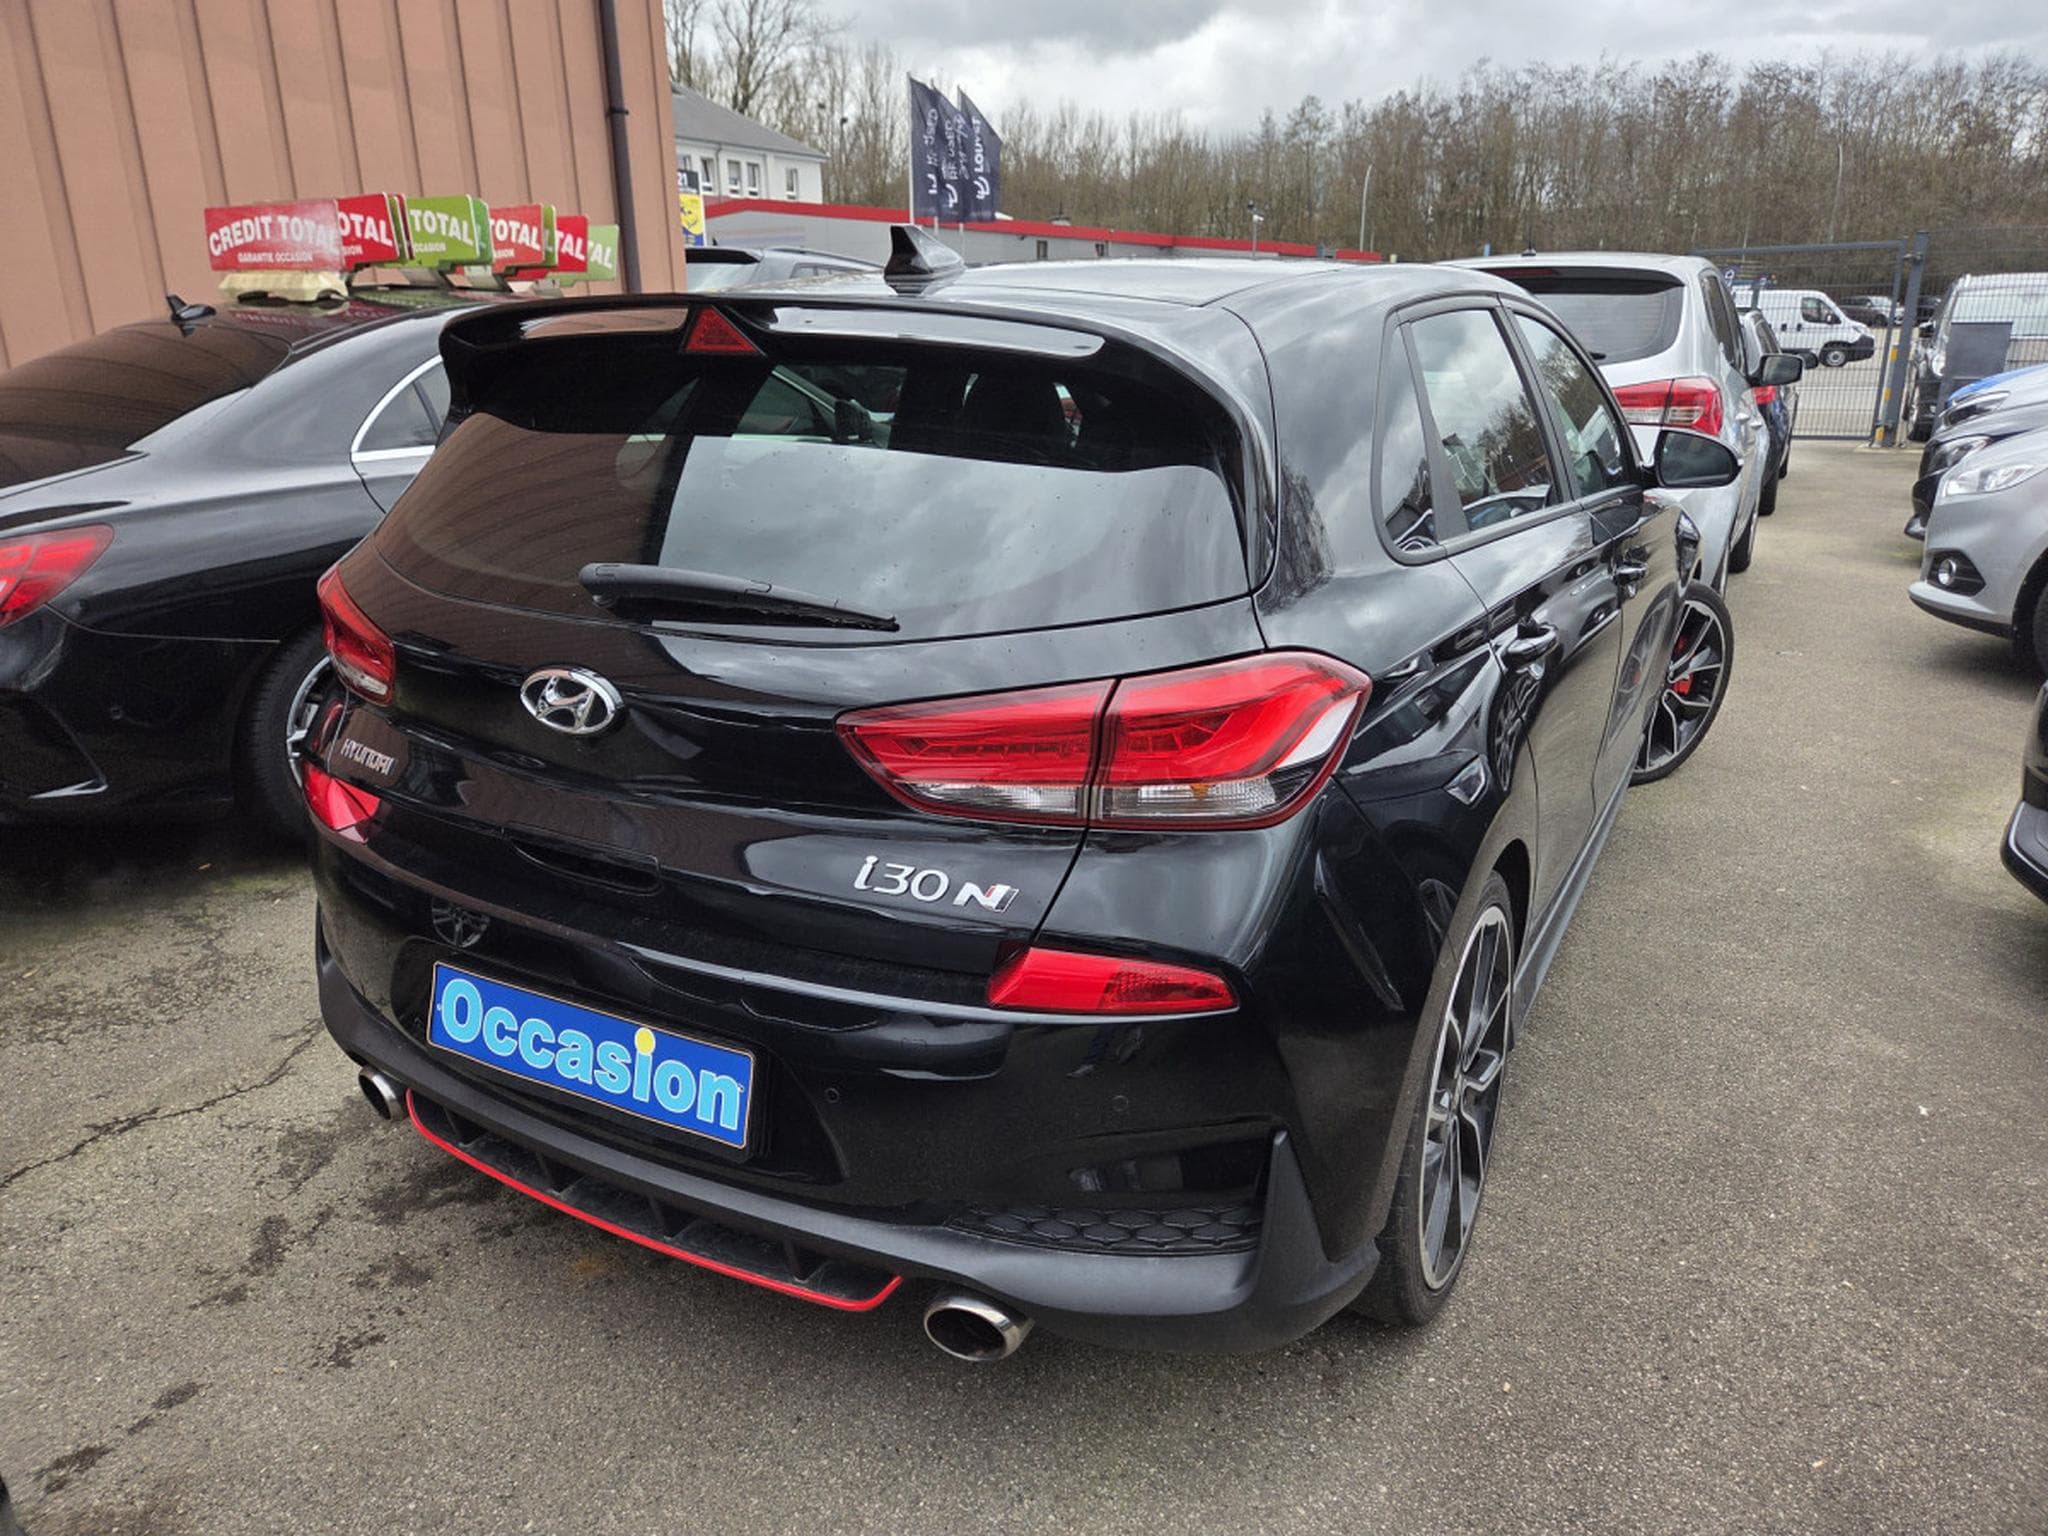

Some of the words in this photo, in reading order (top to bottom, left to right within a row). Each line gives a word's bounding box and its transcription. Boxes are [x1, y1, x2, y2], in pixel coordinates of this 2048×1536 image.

[209, 215, 273, 257] CREDIT
[277, 214, 340, 257] TOTAL
[337, 211, 394, 247] OTAL
[409, 208, 474, 246] TOTAL
[340, 738, 395, 776] HYUNDAI
[854, 855, 950, 903] i30
[952, 881, 1020, 914] N
[441, 978, 744, 1131] Occasion
